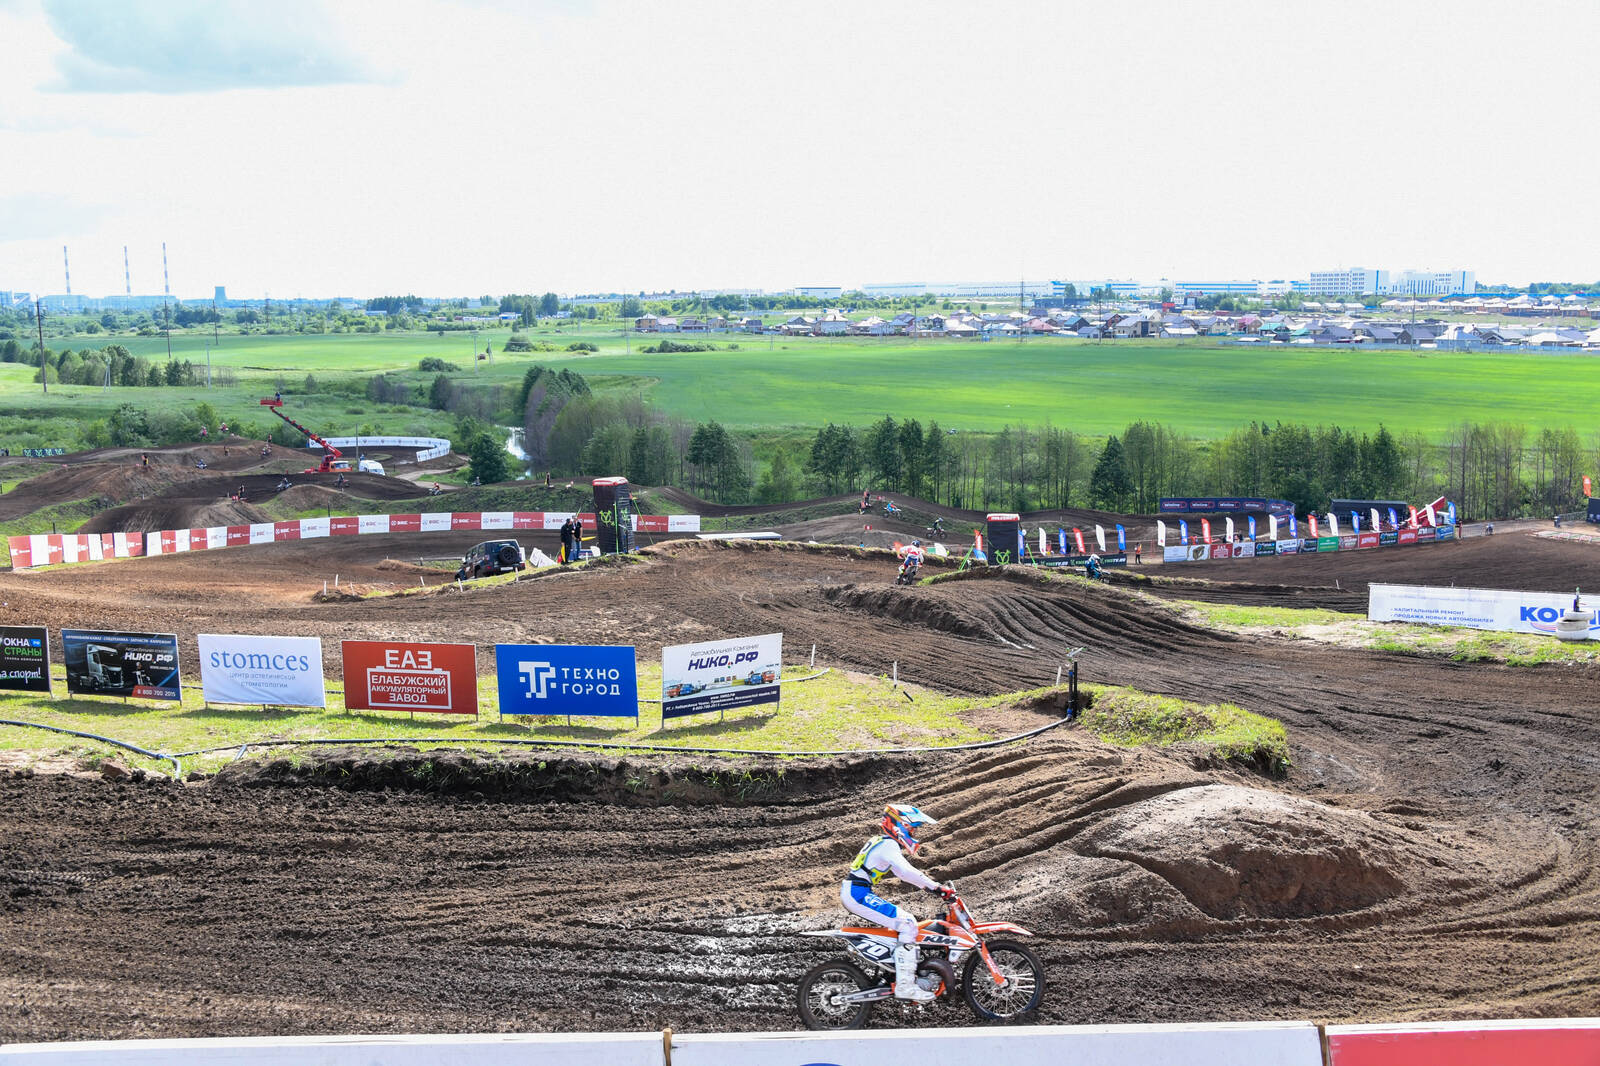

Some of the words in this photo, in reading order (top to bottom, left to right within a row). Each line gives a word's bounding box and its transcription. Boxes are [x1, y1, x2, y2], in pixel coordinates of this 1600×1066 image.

[4, 637, 30, 647] ОКНА
[4, 647, 42, 657] СТРАНЫ
[124, 651, 173, 663] НИКО.РФ
[210, 651, 310, 672] stomces
[385, 649, 432, 669] ЕАЗ
[688, 651, 759, 671] НИКО.РФ
[9, 667, 41, 684] спорт!
[561, 667, 620, 680] ТЕХНО
[371, 674, 446, 686] ЕЛАБУЖСКИЙ
[371, 686, 447, 695] АККУМУЛЯТОРНЫЙ
[562, 683, 621, 695] ГОРОД
[389, 693, 428, 703] ЗАВОД
[923, 934, 959, 946] KTM
